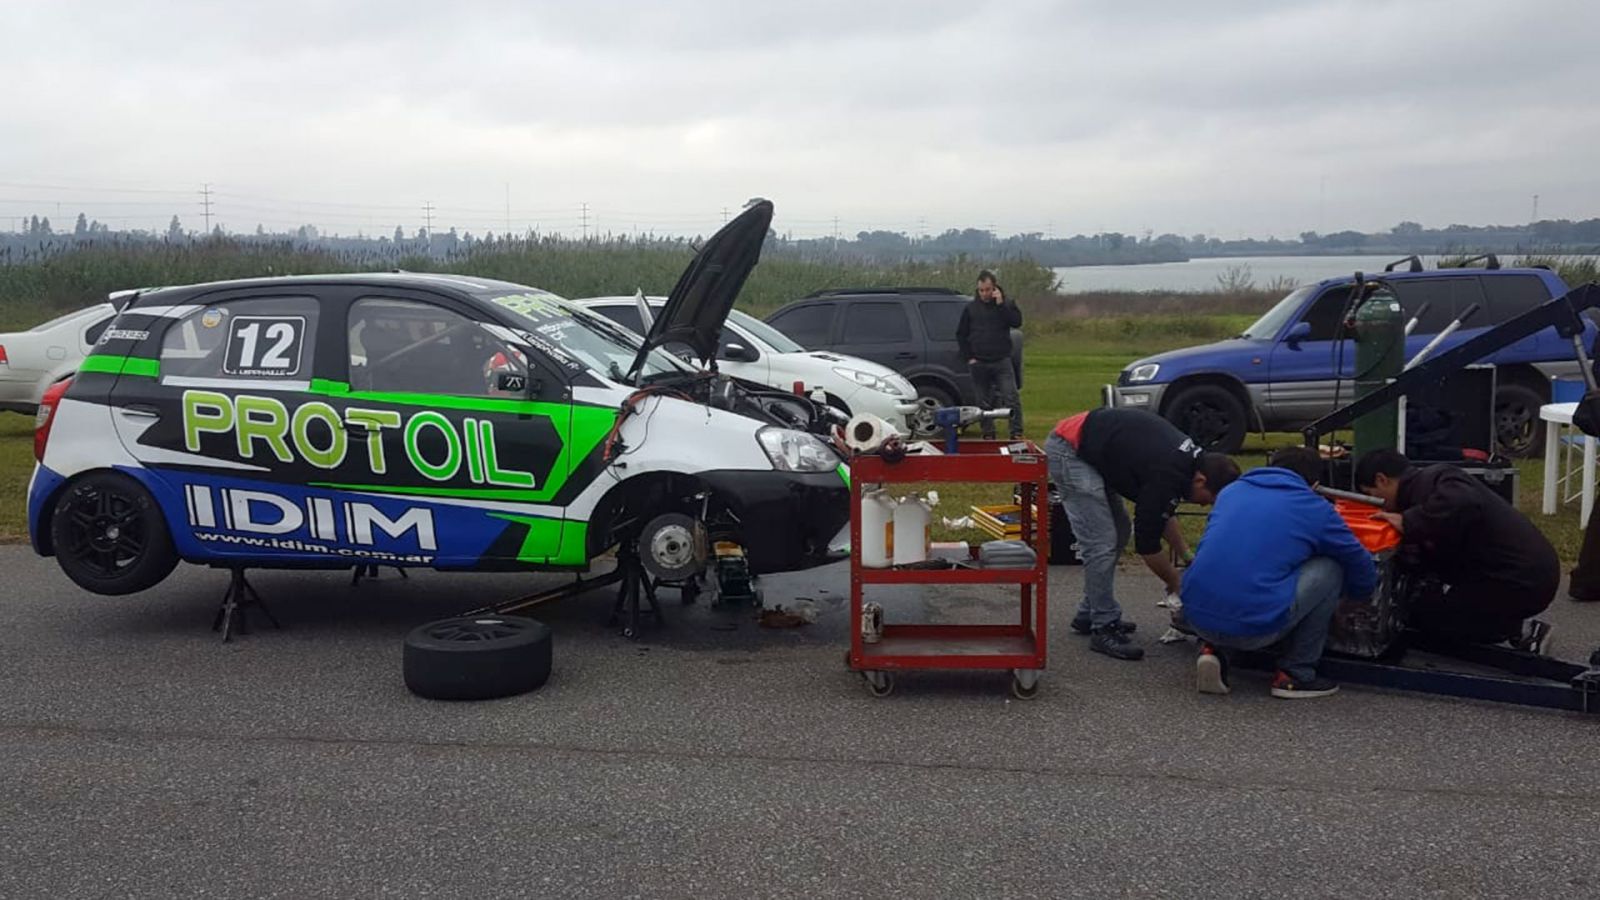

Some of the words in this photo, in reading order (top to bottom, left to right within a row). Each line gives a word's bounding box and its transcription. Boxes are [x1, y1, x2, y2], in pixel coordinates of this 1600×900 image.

[237, 322, 295, 368] 12
[182, 389, 536, 488] PROTOIL
[184, 483, 439, 550] IDIM
[195, 531, 434, 564] www.idim.com.ar
